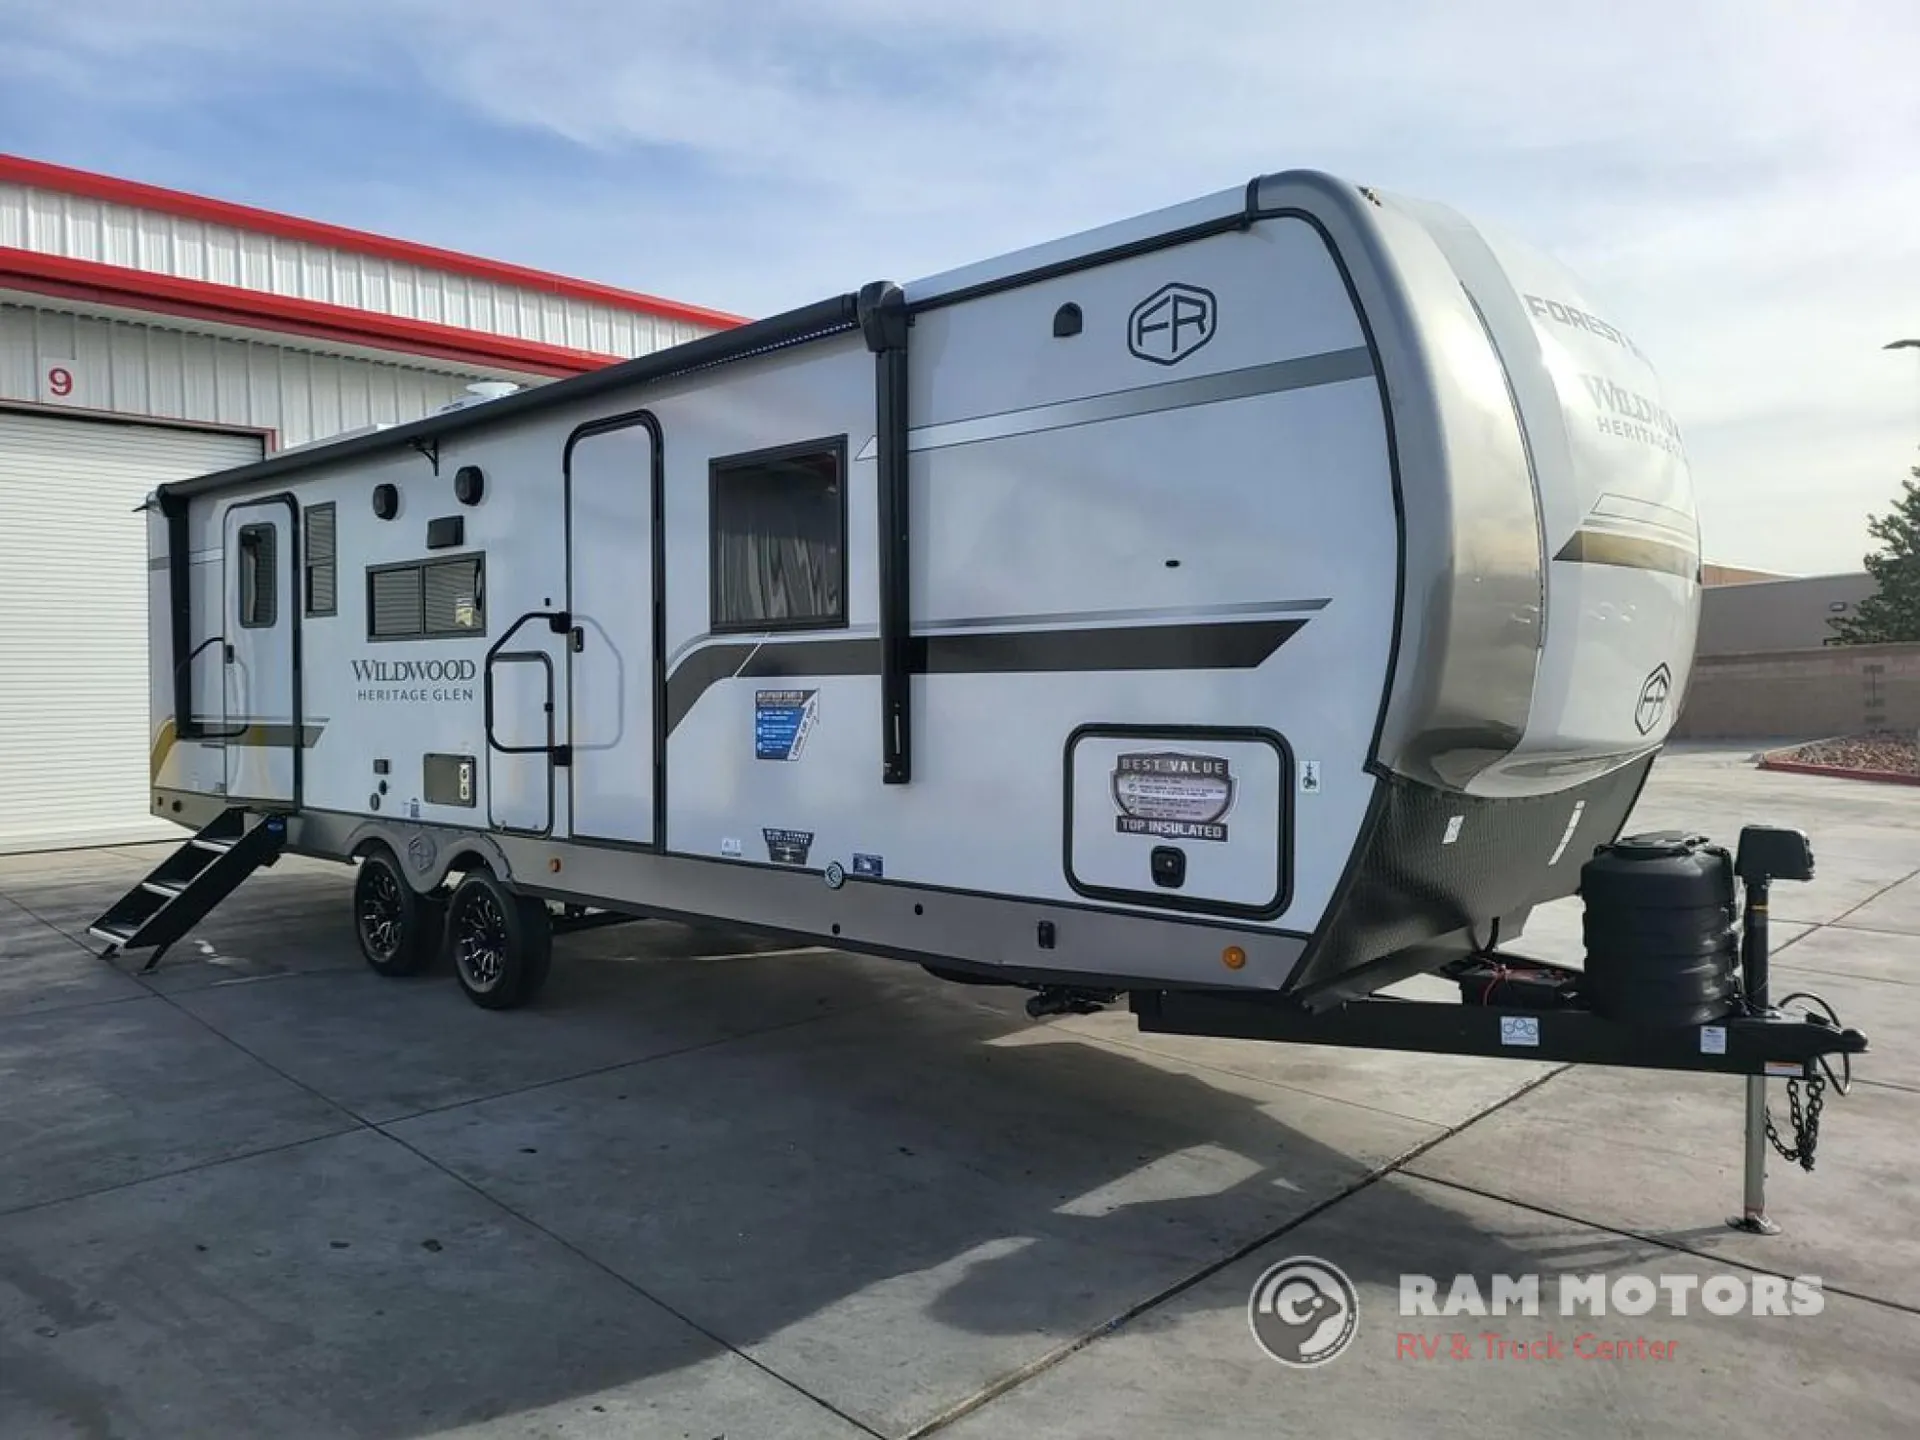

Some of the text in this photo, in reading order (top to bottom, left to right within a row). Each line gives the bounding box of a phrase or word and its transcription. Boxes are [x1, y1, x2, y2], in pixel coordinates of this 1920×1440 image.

[1523, 293, 1627, 349] FOREST
[48, 367, 72, 396] 9
[357, 688, 474, 702] HERITAGE GLEN
[1121, 758, 1225, 774] BEST VALUE
[1121, 819, 1223, 838] TOP INSULATED
